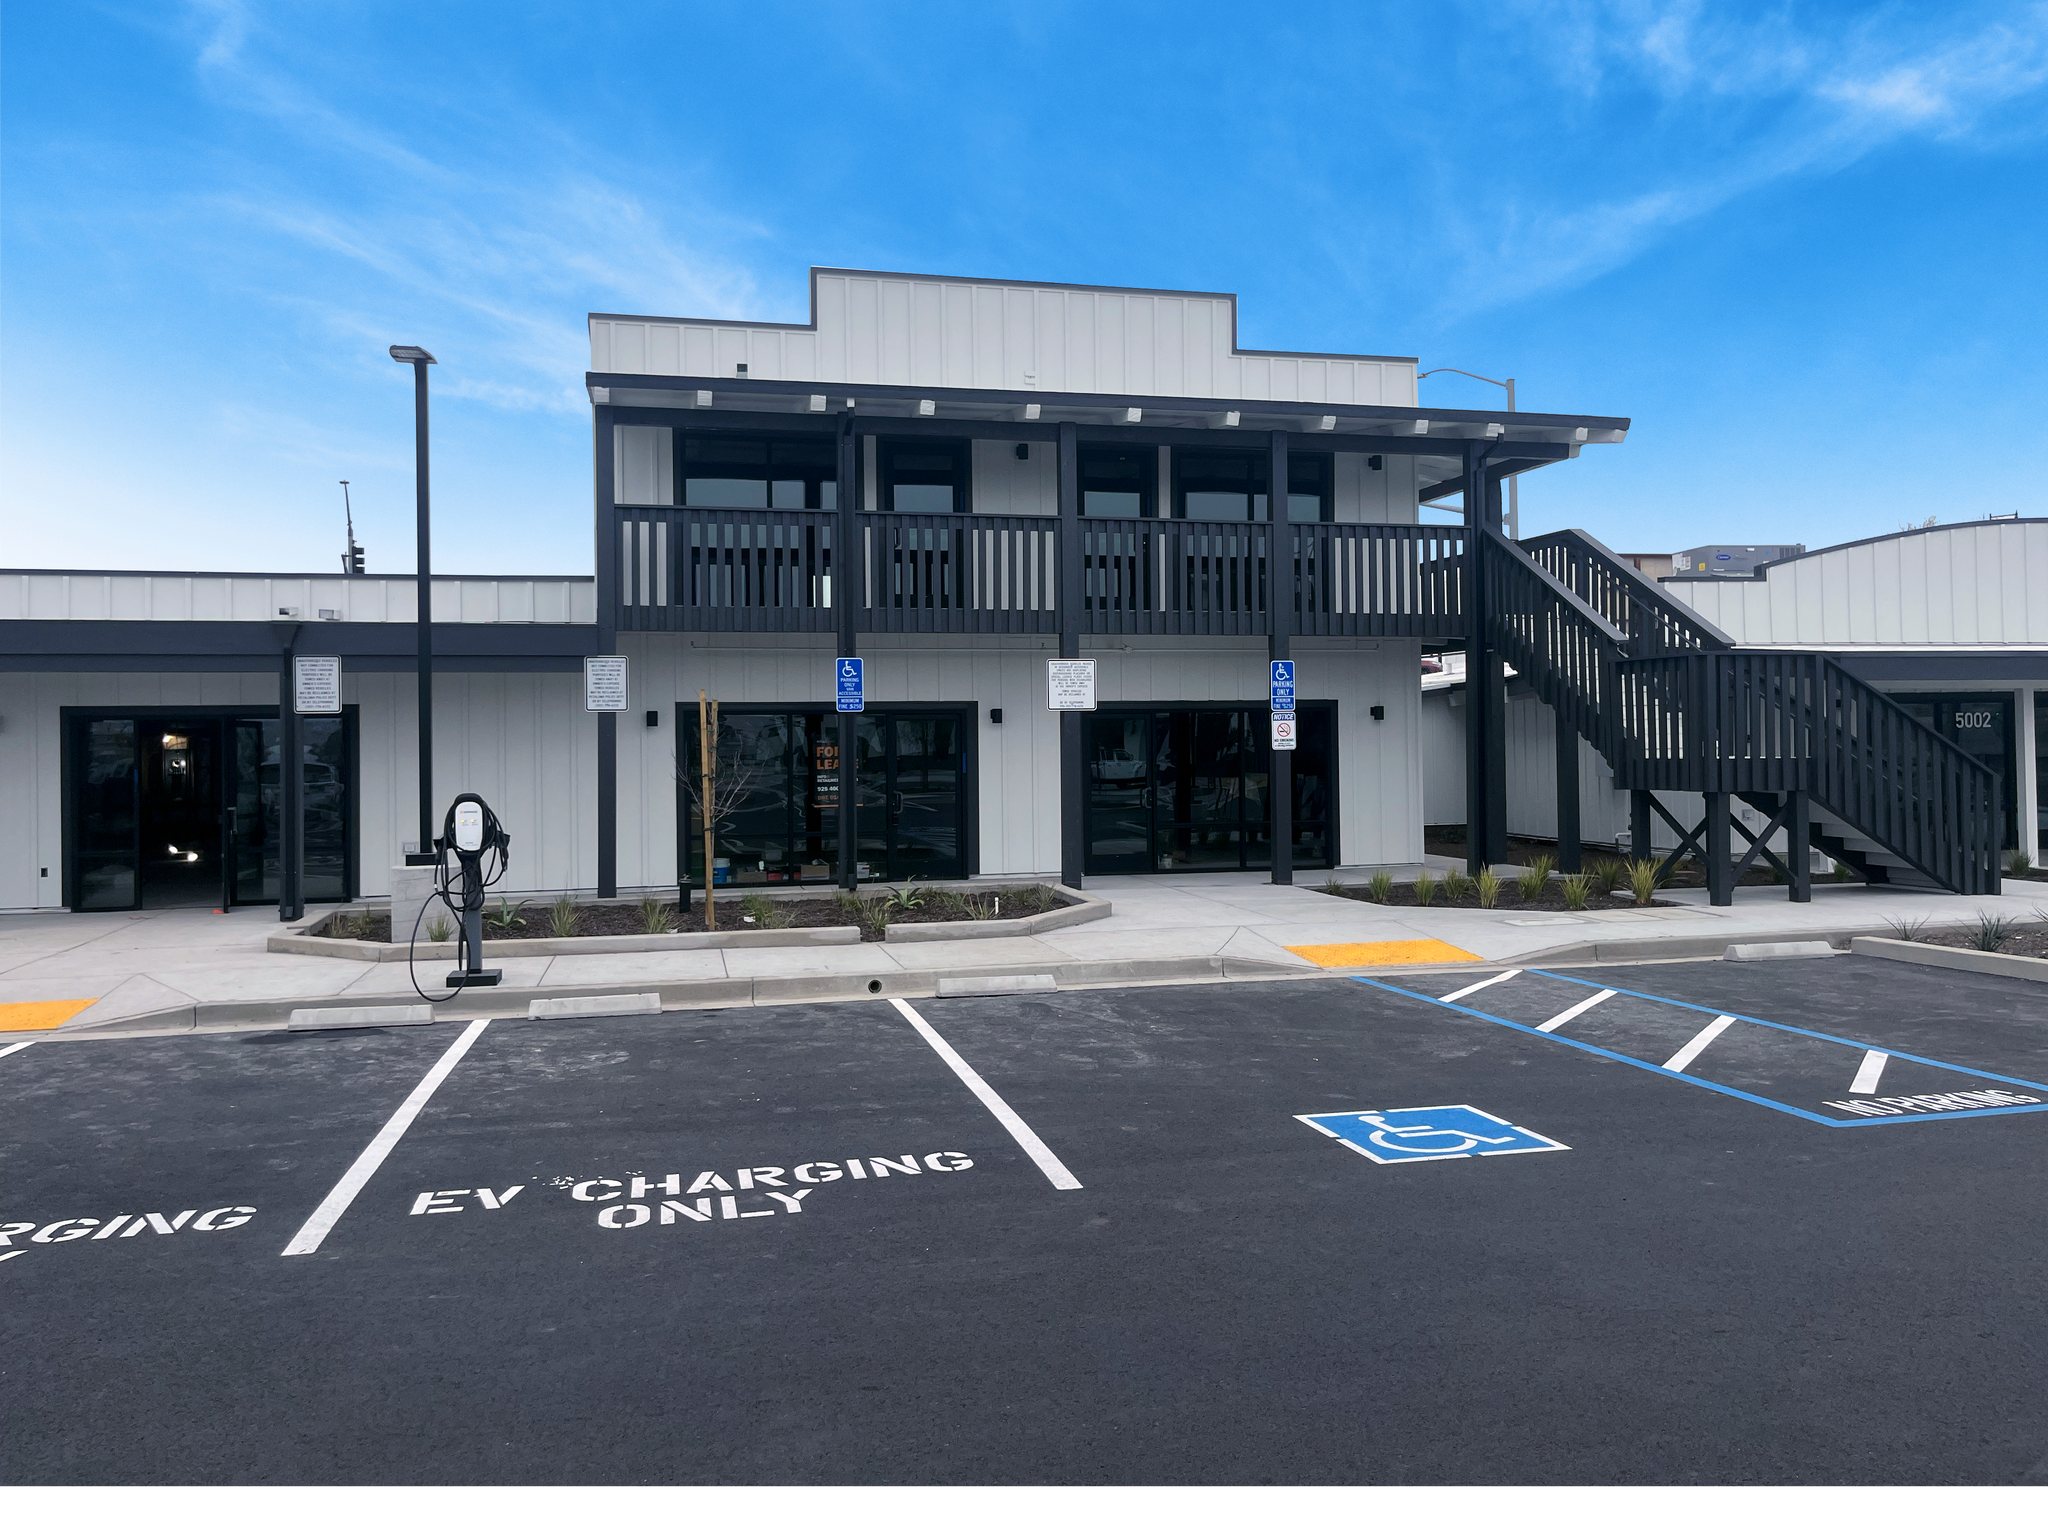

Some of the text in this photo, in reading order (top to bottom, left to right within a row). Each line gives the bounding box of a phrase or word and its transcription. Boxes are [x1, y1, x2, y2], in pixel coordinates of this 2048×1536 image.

[1955, 712, 1991, 728] 5002
[1822, 1090, 2042, 1116] NO PARKING
[409, 1151, 974, 1215] EV CHARGING
[597, 1189, 813, 1229] ONLY
